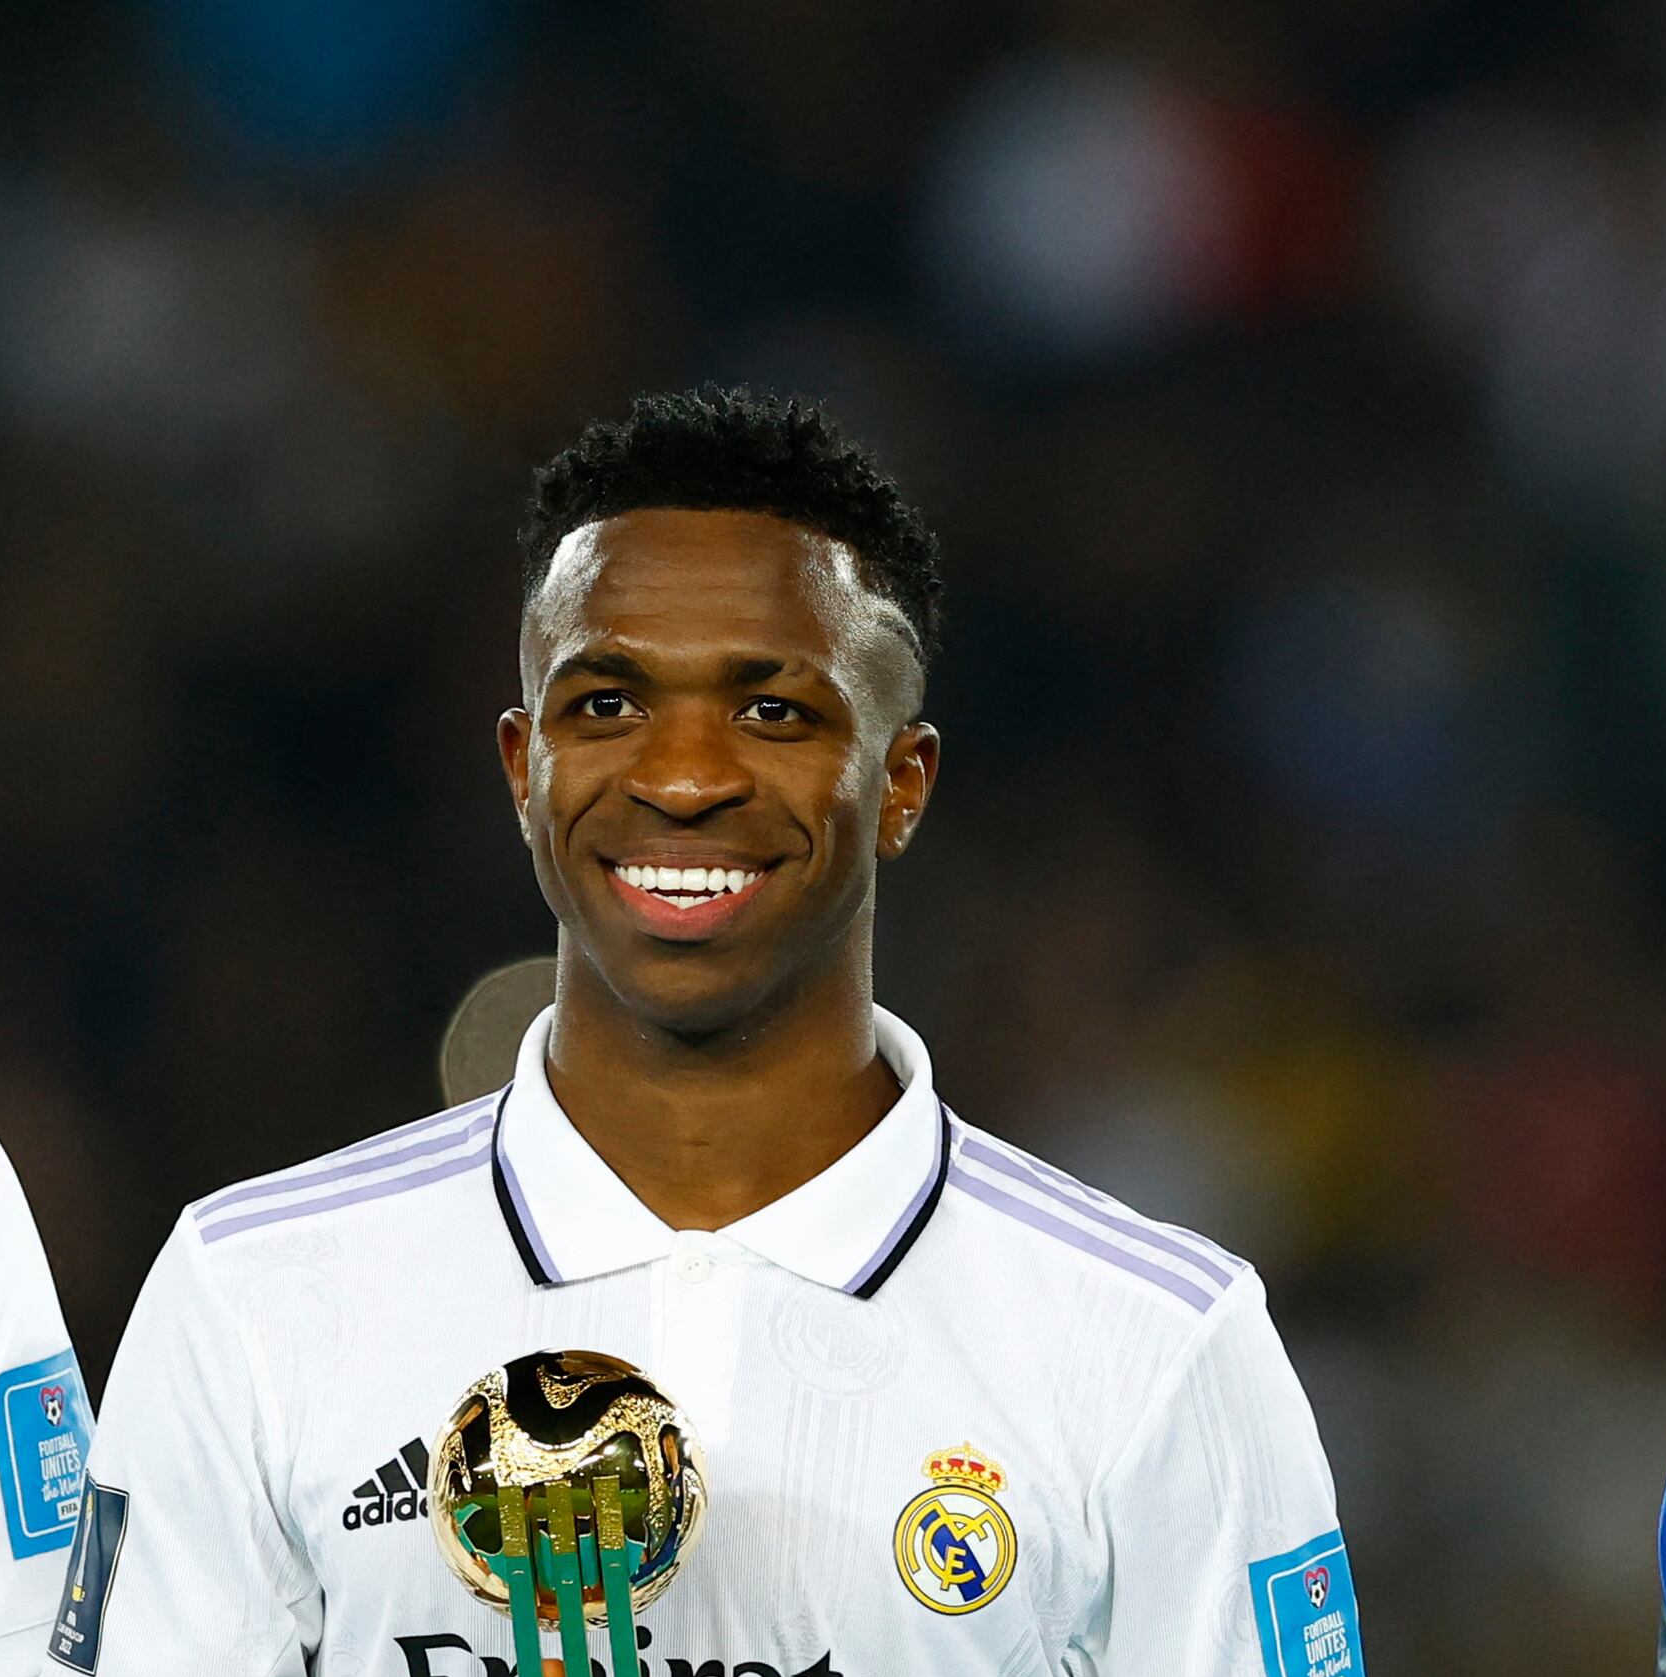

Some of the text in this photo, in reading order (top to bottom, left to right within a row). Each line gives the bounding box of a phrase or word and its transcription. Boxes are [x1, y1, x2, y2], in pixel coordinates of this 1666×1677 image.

[40, 1448, 81, 1481] UNITES
[58, 1471, 81, 1498] Worl
[60, 1502, 79, 1515] FIFA
[342, 1489, 429, 1531] adid
[1303, 1610, 1344, 1642] FOOTBALL
[1305, 1627, 1347, 1665] UNITES
